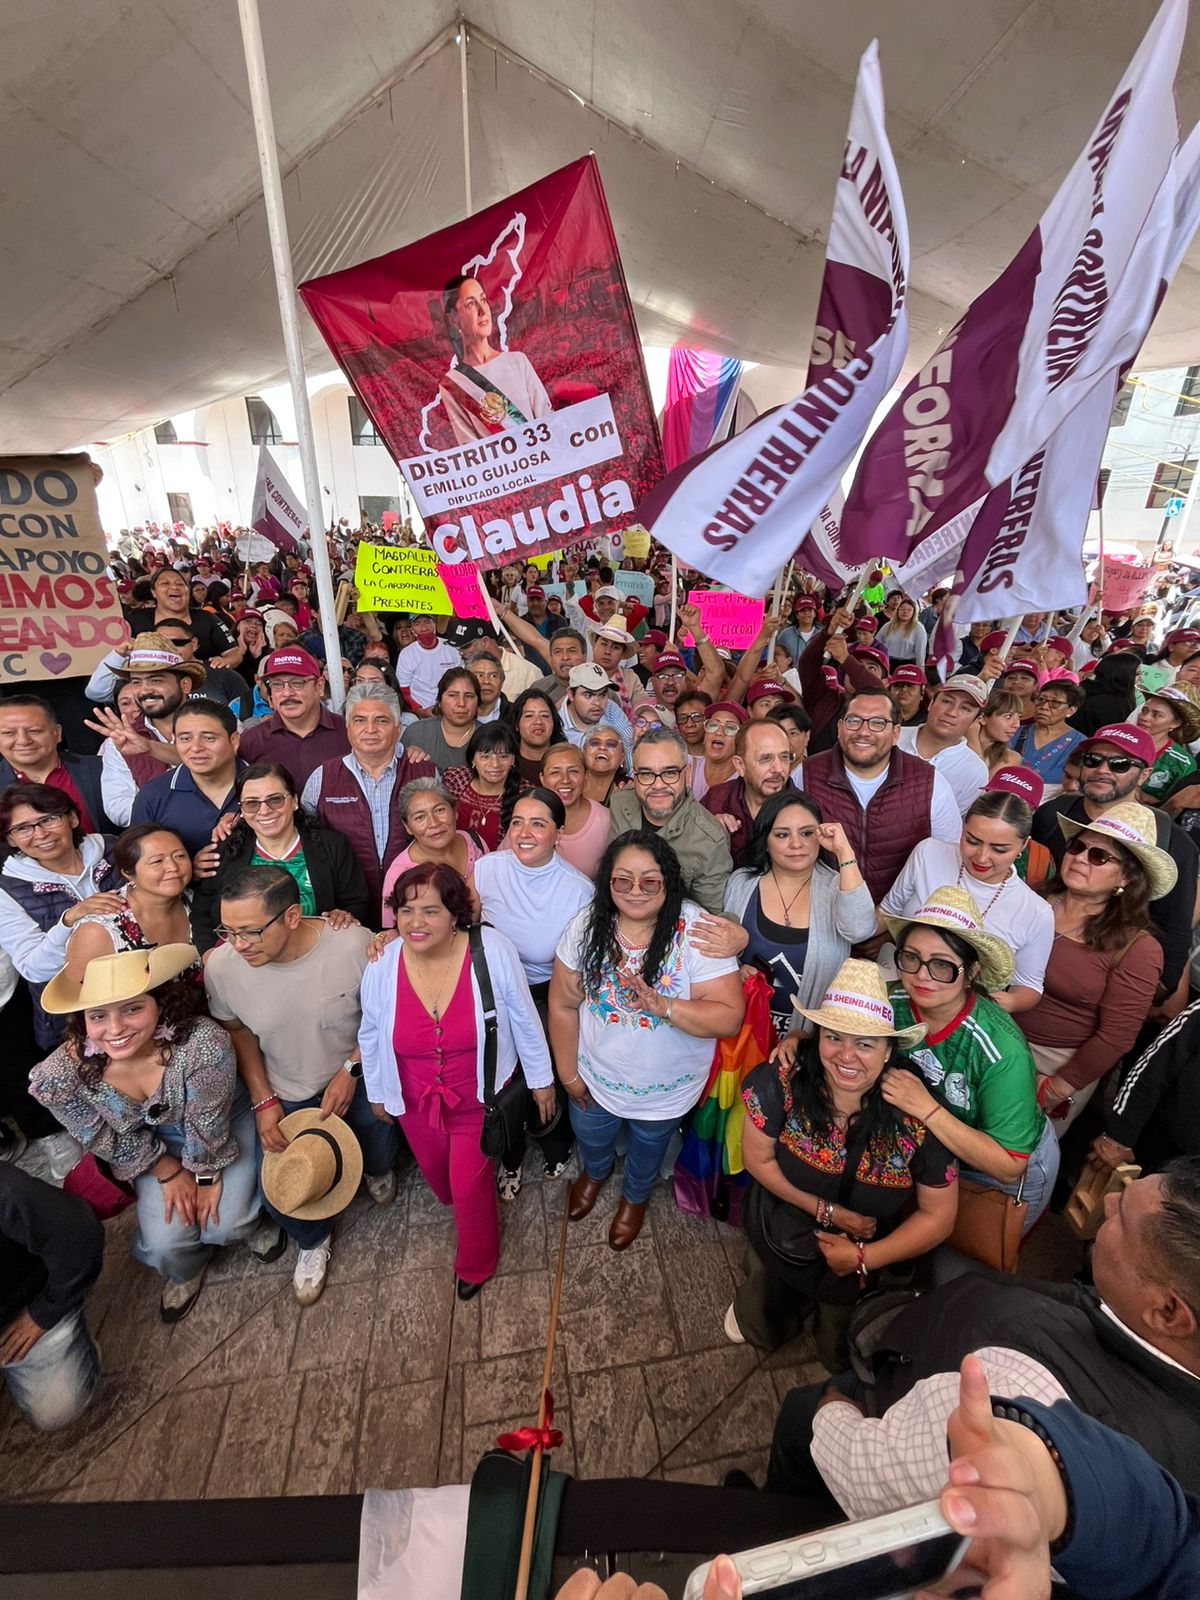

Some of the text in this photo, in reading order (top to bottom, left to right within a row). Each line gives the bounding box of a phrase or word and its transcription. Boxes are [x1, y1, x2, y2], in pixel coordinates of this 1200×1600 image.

[570, 420, 615, 448] con
[409, 423, 551, 481] DISTRITO 33
[422, 450, 551, 498] EMILIO GUIJOSA
[447, 474, 536, 506] DIPUTADO LOCAL
[271, 490, 302, 528] CONTRERAS
[432, 474, 635, 564] Claudia
[0, 513, 79, 539] CON
[372, 561, 439, 578] CONTRERAS
[373, 596, 433, 611] PRESENTES
[274, 655, 302, 663] morena
[1101, 729, 1139, 744] México
[1000, 773, 1033, 791] México
[923, 906, 969, 926] SHEINBAUM
[833, 994, 882, 1014] SHEINBAUM
